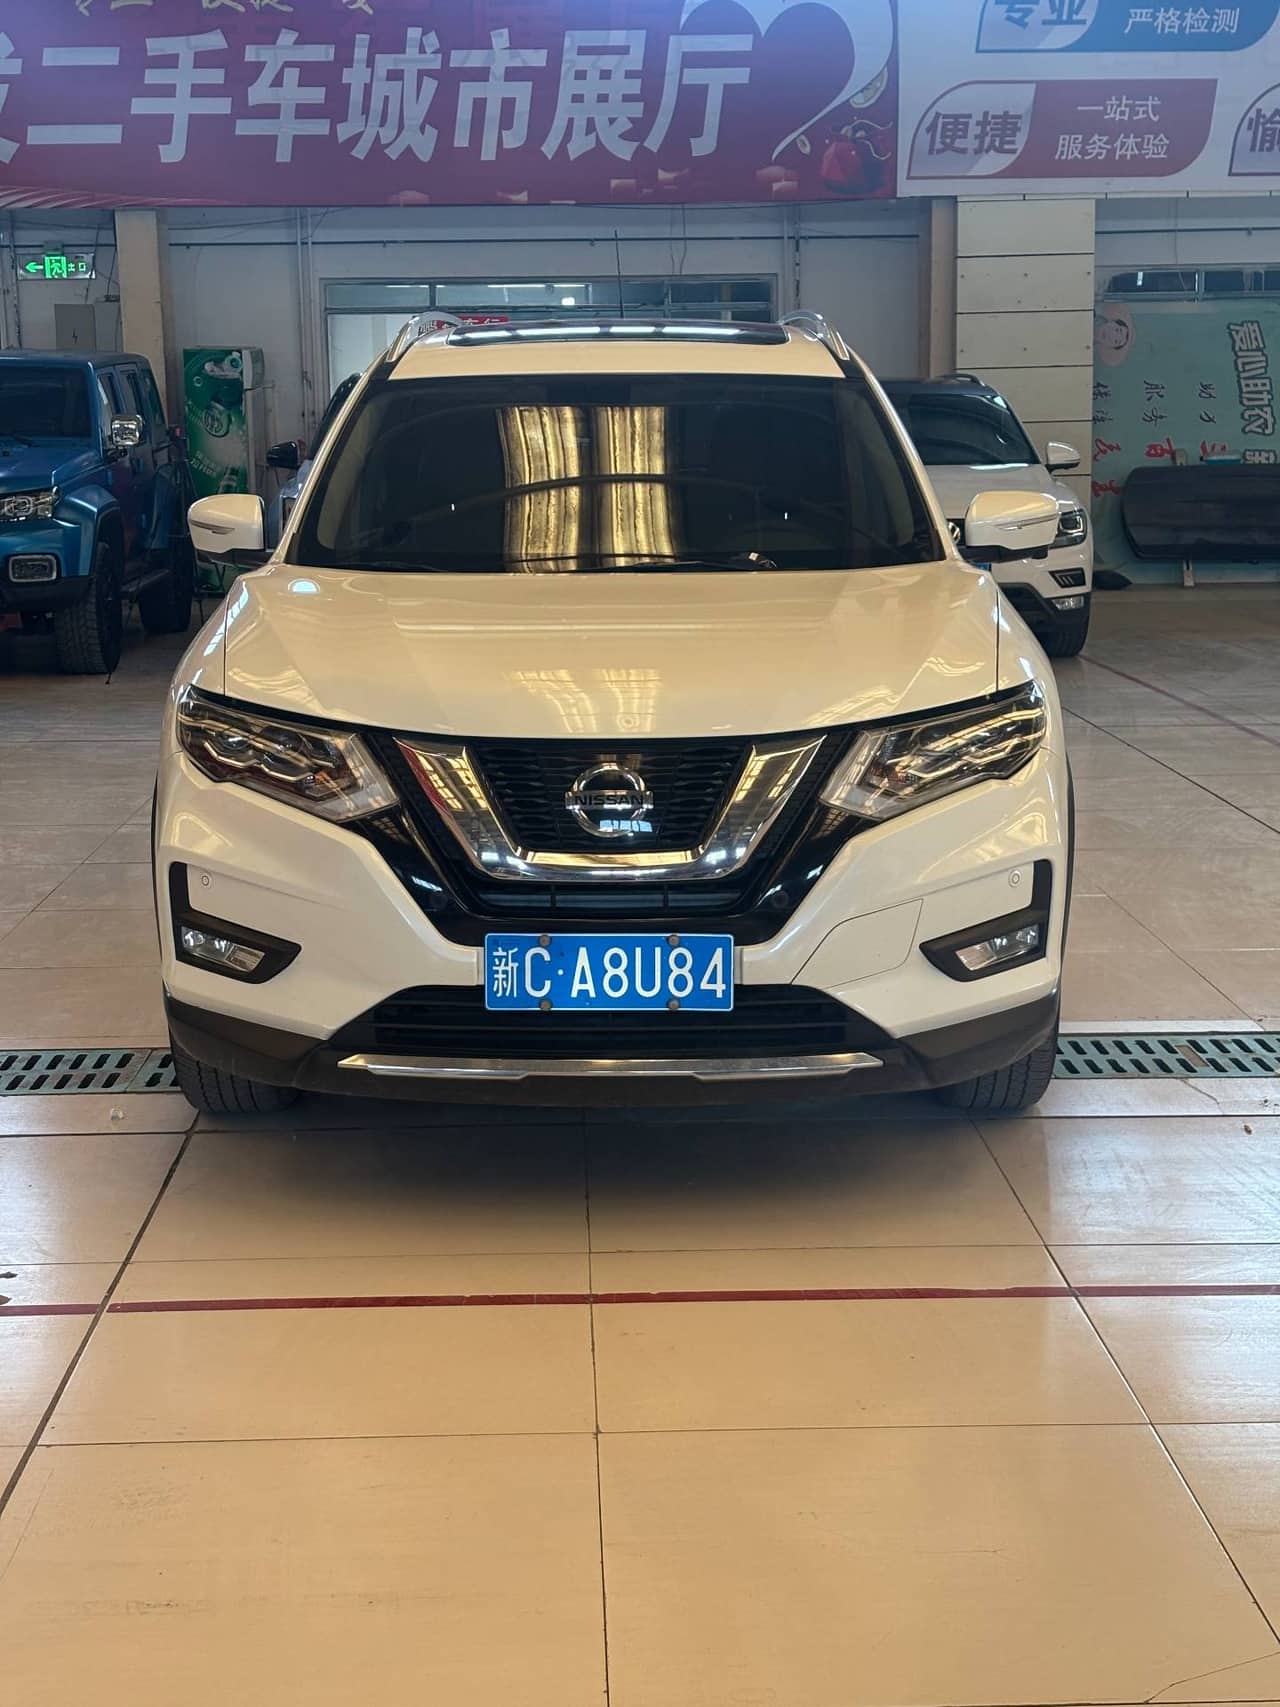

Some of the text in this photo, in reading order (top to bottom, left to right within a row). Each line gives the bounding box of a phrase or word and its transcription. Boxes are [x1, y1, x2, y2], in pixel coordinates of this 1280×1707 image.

[995, 0, 1087, 28] 专业
[1124, 8, 1240, 34] 严格检测
[0, 28, 754, 163] 二手车城市展厅
[1076, 96, 1161, 122] 一站式
[926, 110, 1023, 156] 便捷
[1055, 133, 1170, 161] 服务体验
[1229, 320, 1275, 435] 爱心助农
[574, 794, 645, 806] NISSAN
